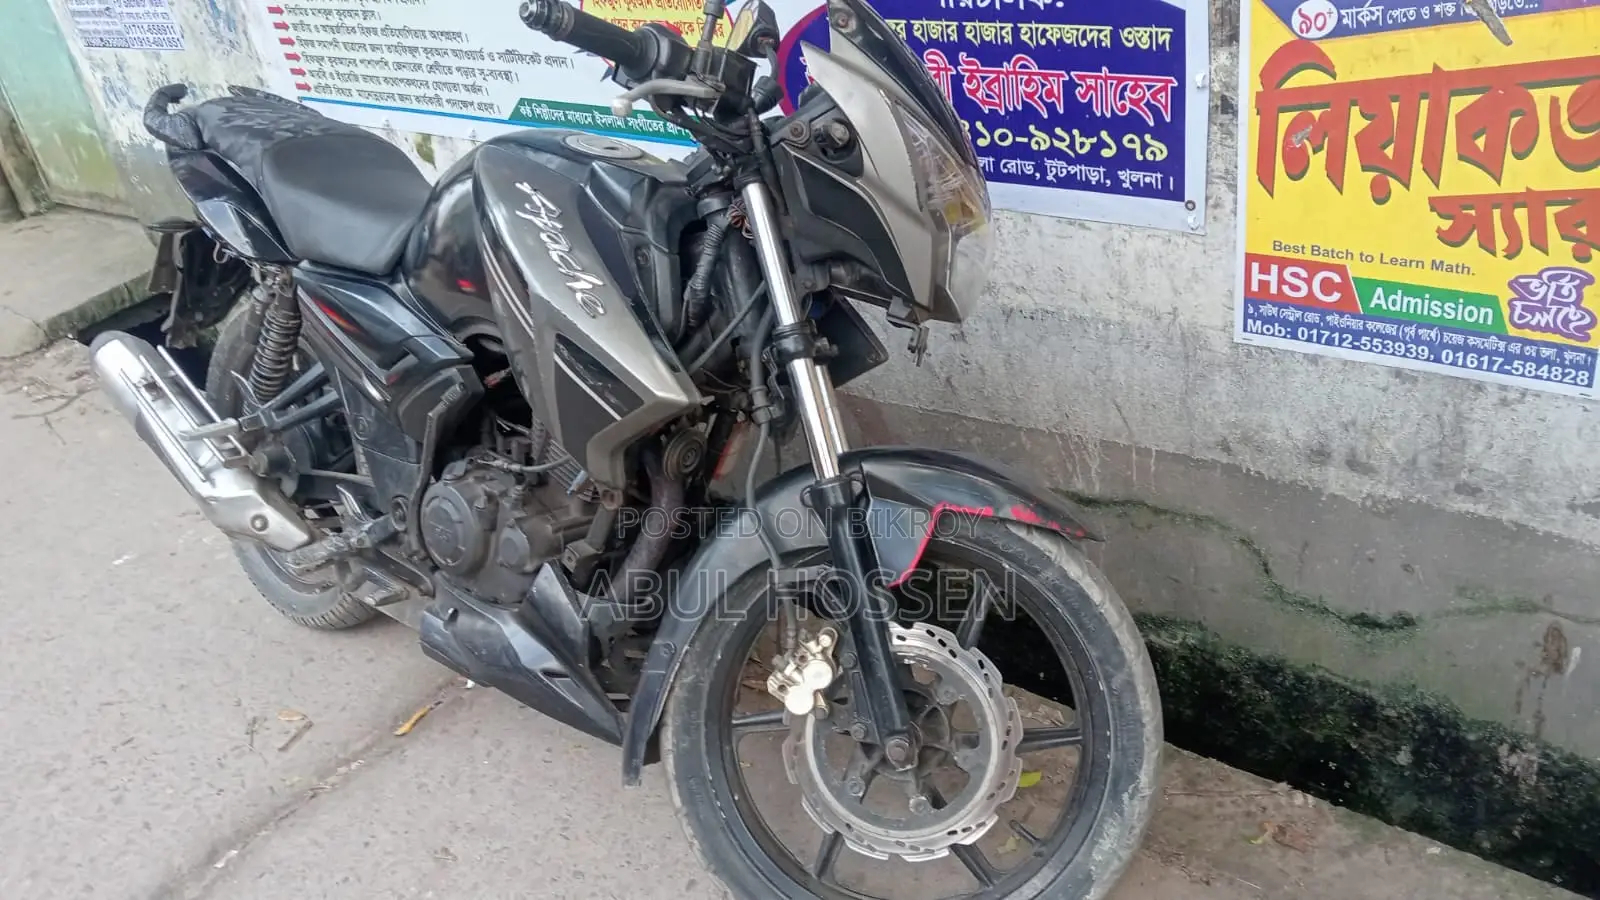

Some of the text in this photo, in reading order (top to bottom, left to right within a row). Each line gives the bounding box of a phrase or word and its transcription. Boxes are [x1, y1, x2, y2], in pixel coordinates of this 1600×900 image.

[1387, 7, 1417, 24] পেতে
[1420, 6, 1430, 19] ও
[911, 18, 958, 44] হাজার
[962, 19, 1013, 47] হাজার
[1018, 20, 1113, 49] হাফেজদের
[1119, 26, 1173, 52] ওস্তাদ
[958, 52, 1068, 118] ইব্রাহিম
[1071, 67, 1178, 126] সাহেব
[1428, 186, 1600, 263] স্যার
[1272, 240, 1476, 277] Best Batch to Learn Math.
[1250, 261, 1343, 303] HSC
[1369, 286, 1494, 325] Admission
[1511, 300, 1592, 337] চলছে
[1247, 318, 1590, 386] Mob: 01712-553939, 01617-584828
